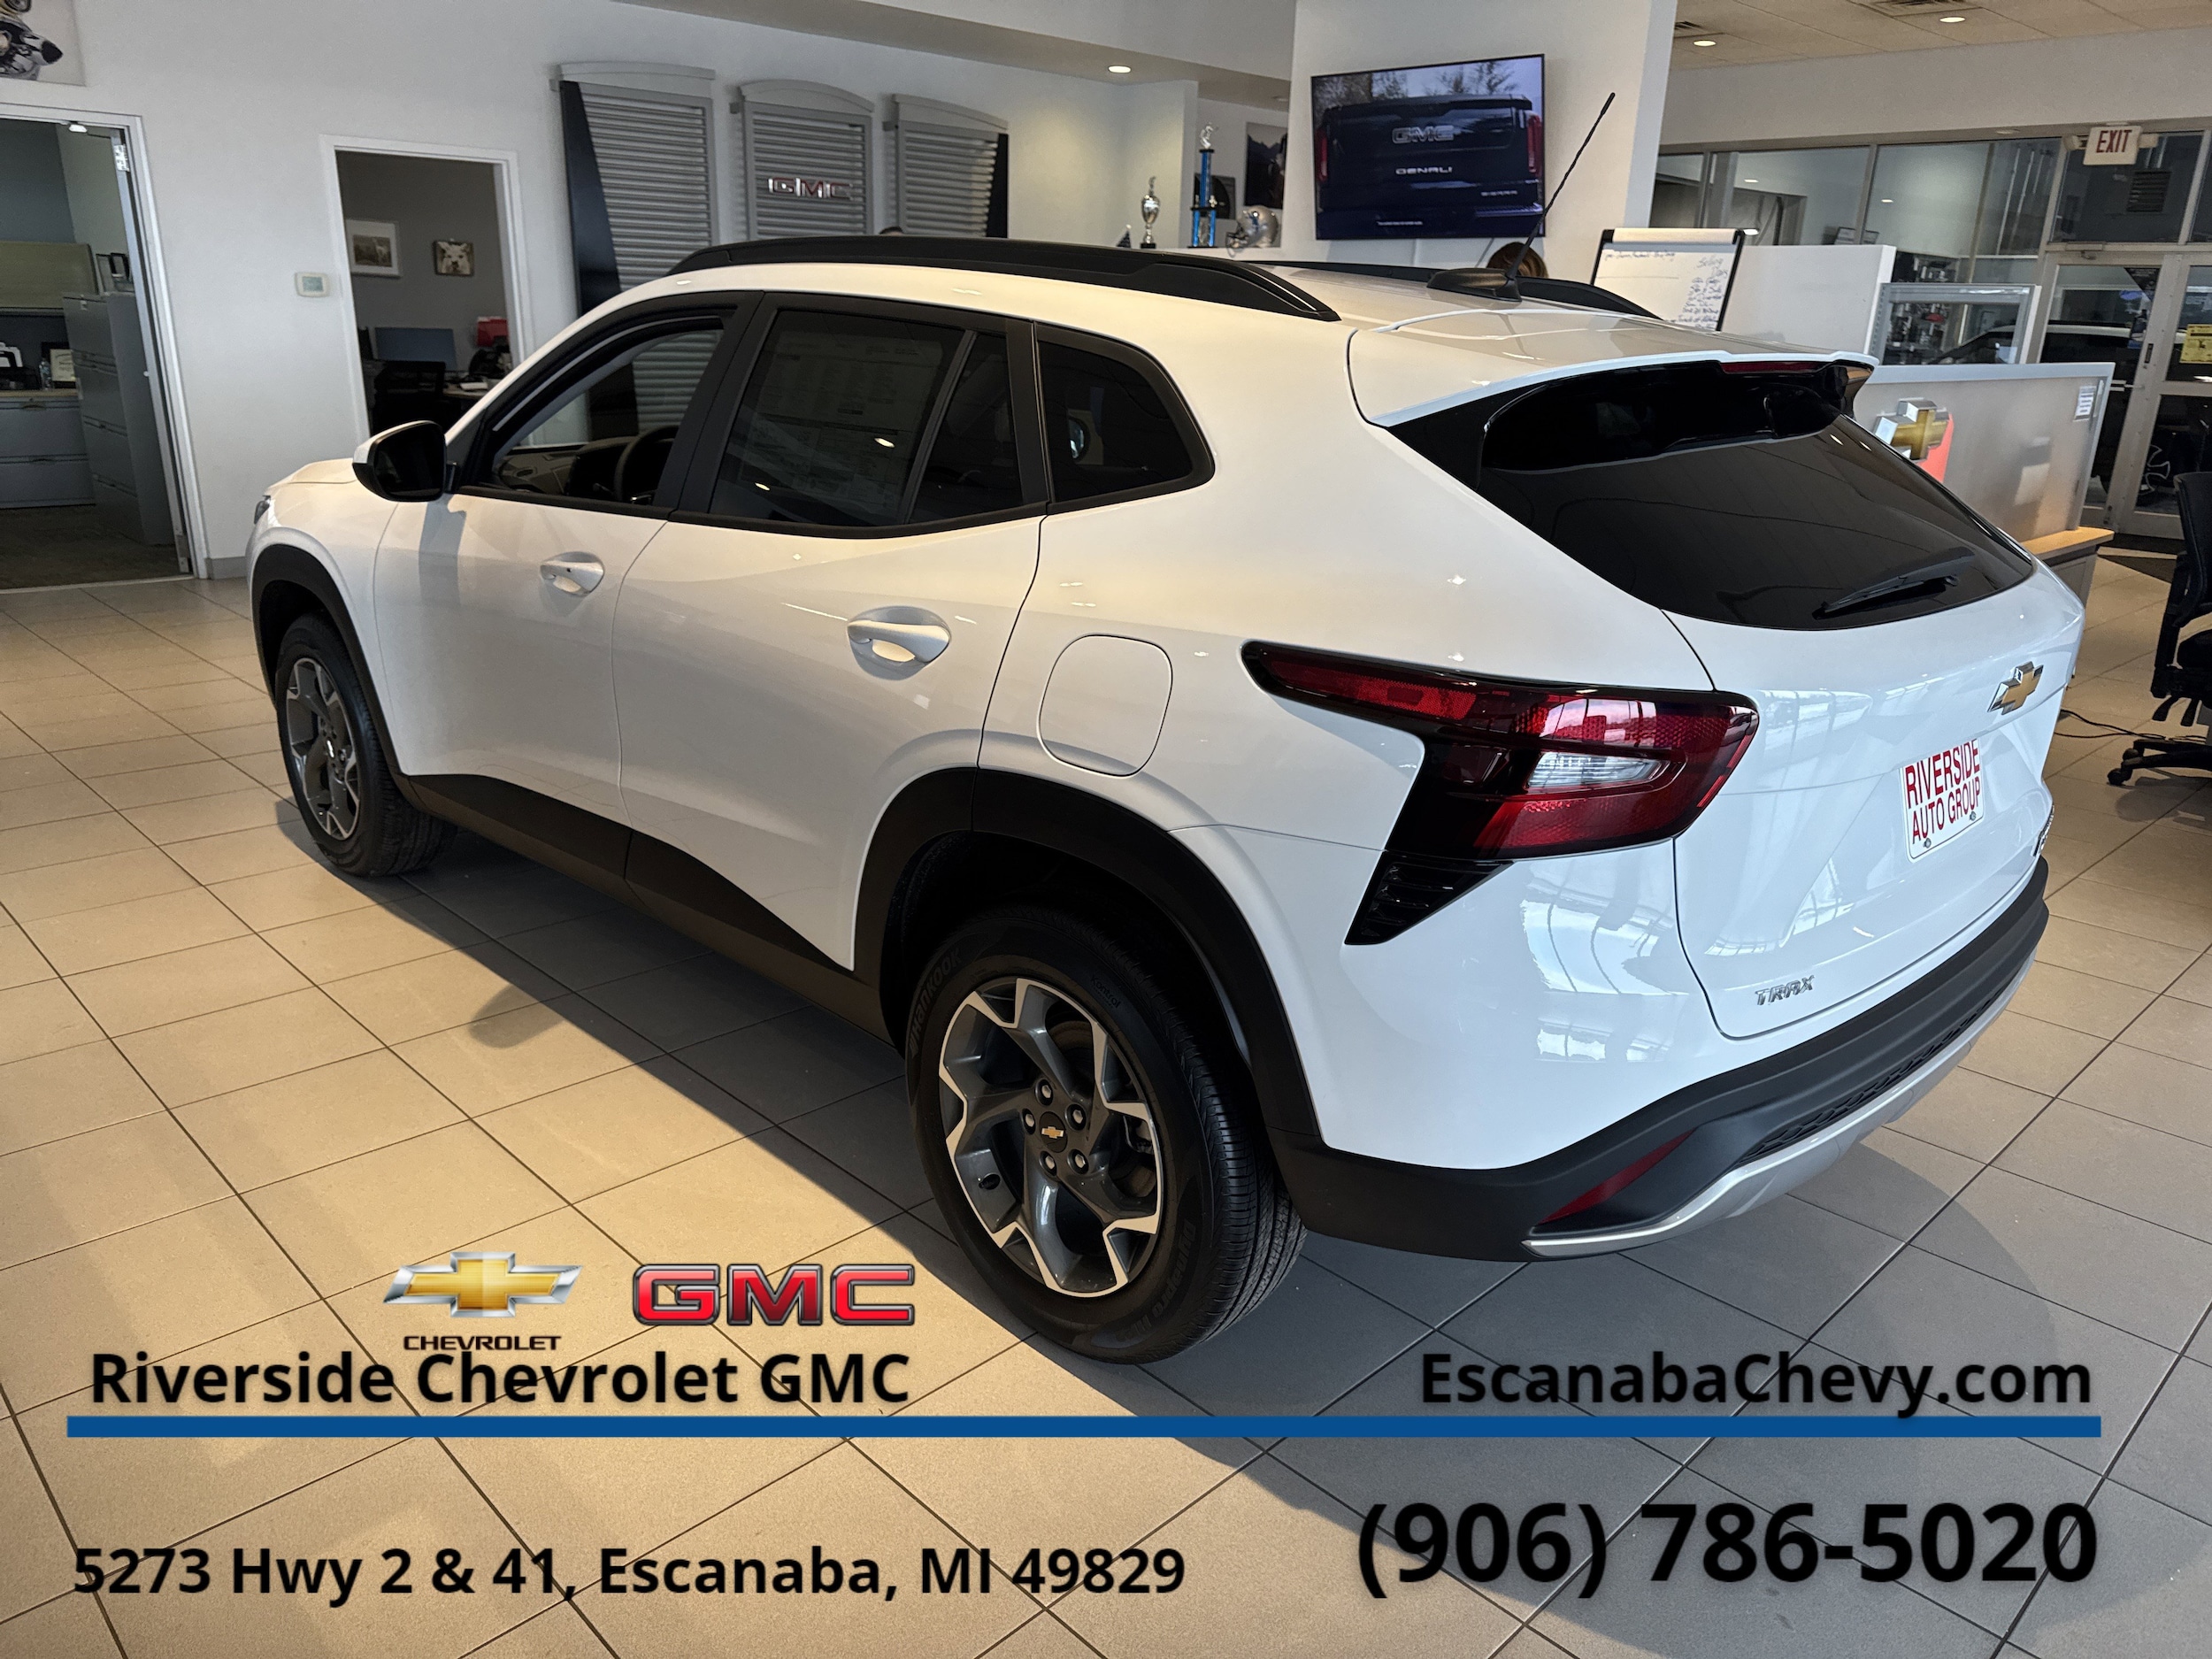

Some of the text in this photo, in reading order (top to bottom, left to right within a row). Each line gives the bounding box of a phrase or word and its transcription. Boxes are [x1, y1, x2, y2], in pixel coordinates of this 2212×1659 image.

[1392, 125, 1454, 143] GMC
[2096, 129, 2132, 153] EXIT
[1395, 165, 1453, 174] DENALI
[768, 177, 853, 201] GMC
[1905, 738, 1980, 809] RIVERSIDE
[1912, 776, 1980, 844] AUTO GROUP
[1755, 975, 1815, 1005] TRAX
